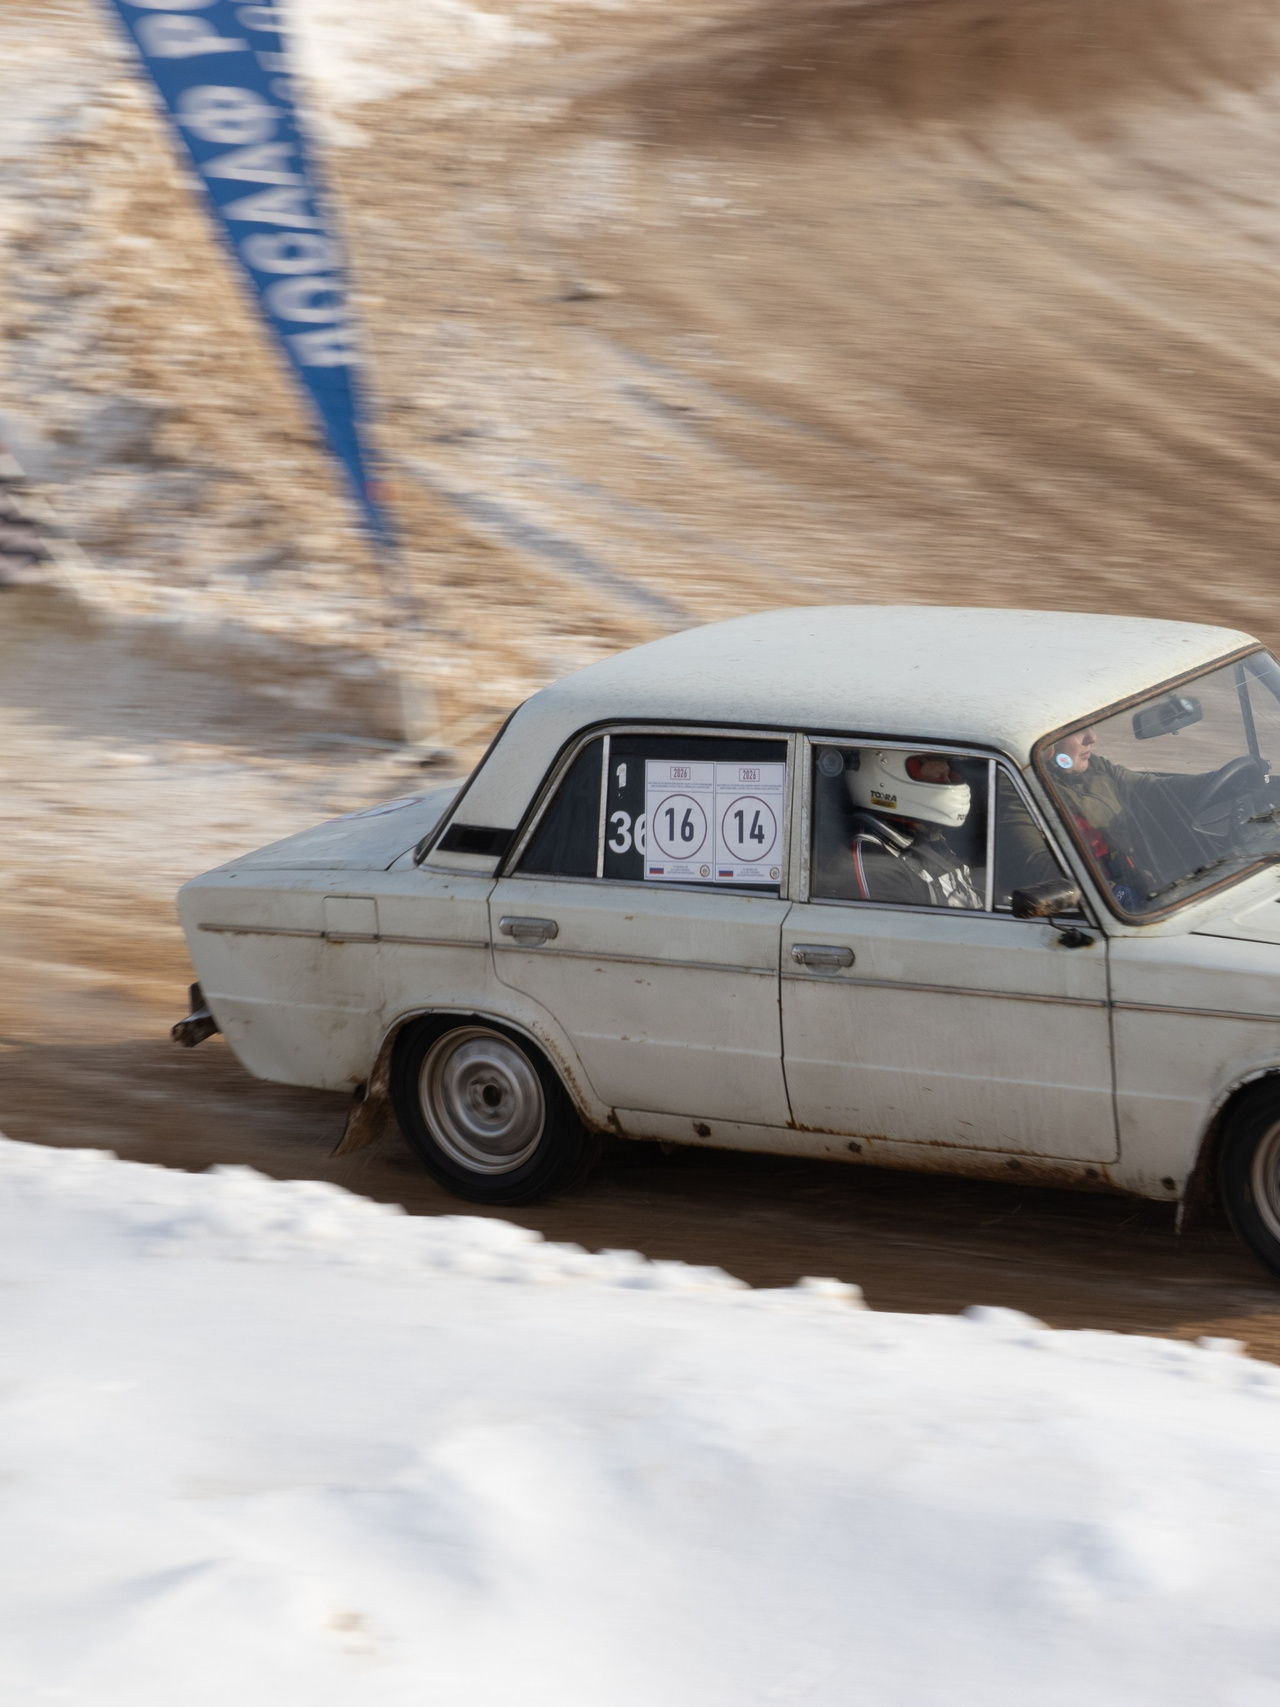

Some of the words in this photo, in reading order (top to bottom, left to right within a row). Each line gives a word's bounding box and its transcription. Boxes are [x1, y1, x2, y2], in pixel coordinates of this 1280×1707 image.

[674, 768, 687, 778] 2026
[742, 770, 757, 780] 2026
[665, 807, 694, 843] 16
[734, 809, 765, 844] 14
